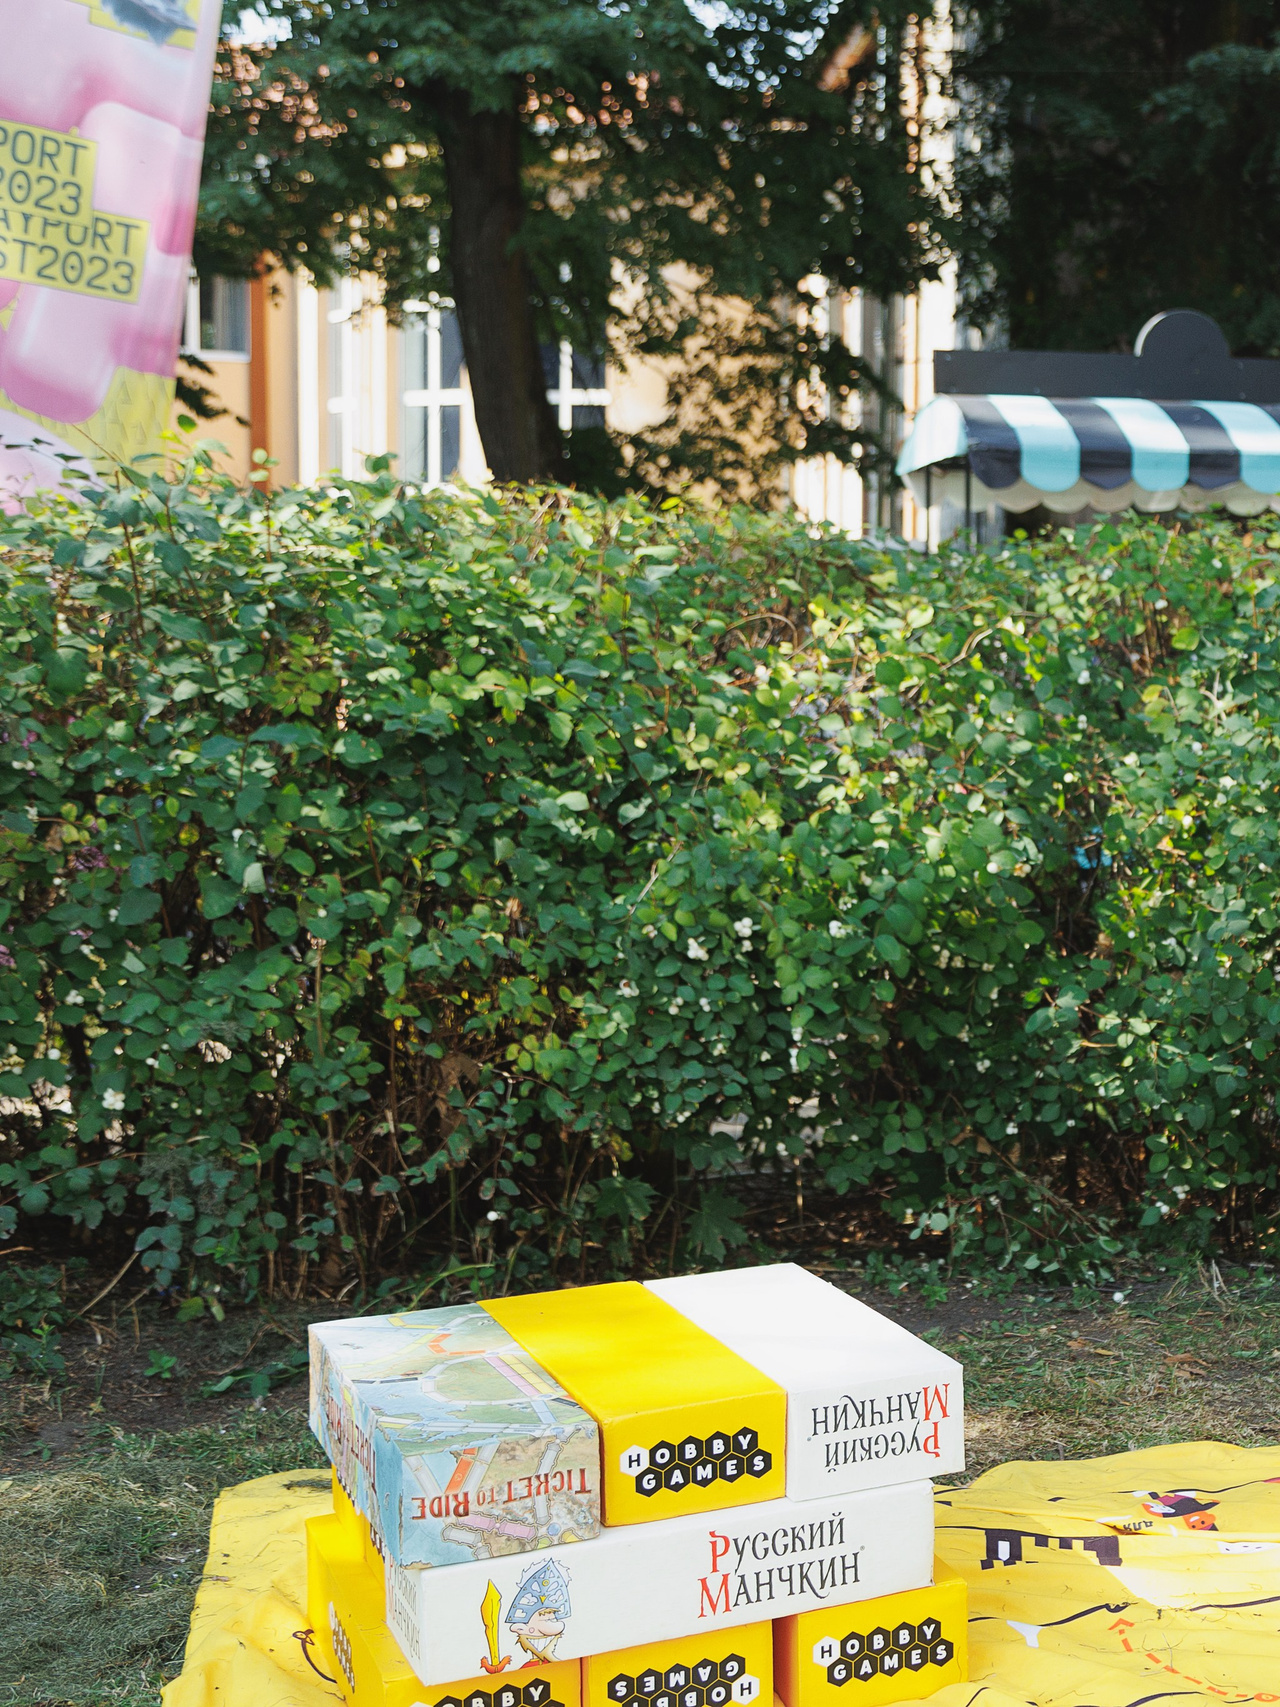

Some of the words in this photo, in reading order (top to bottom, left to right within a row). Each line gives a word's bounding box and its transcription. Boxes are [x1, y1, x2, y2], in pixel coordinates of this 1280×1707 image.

[626, 1432, 754, 1470] HOBBY
[501, 1466, 592, 1498] TICKET
[640, 1453, 766, 1491] GAMES
[411, 1490, 471, 1521] RIDE
[819, 1622, 937, 1661] HOBBY
[614, 1660, 740, 1697] GAMES
[832, 1643, 949, 1682] GAMES
